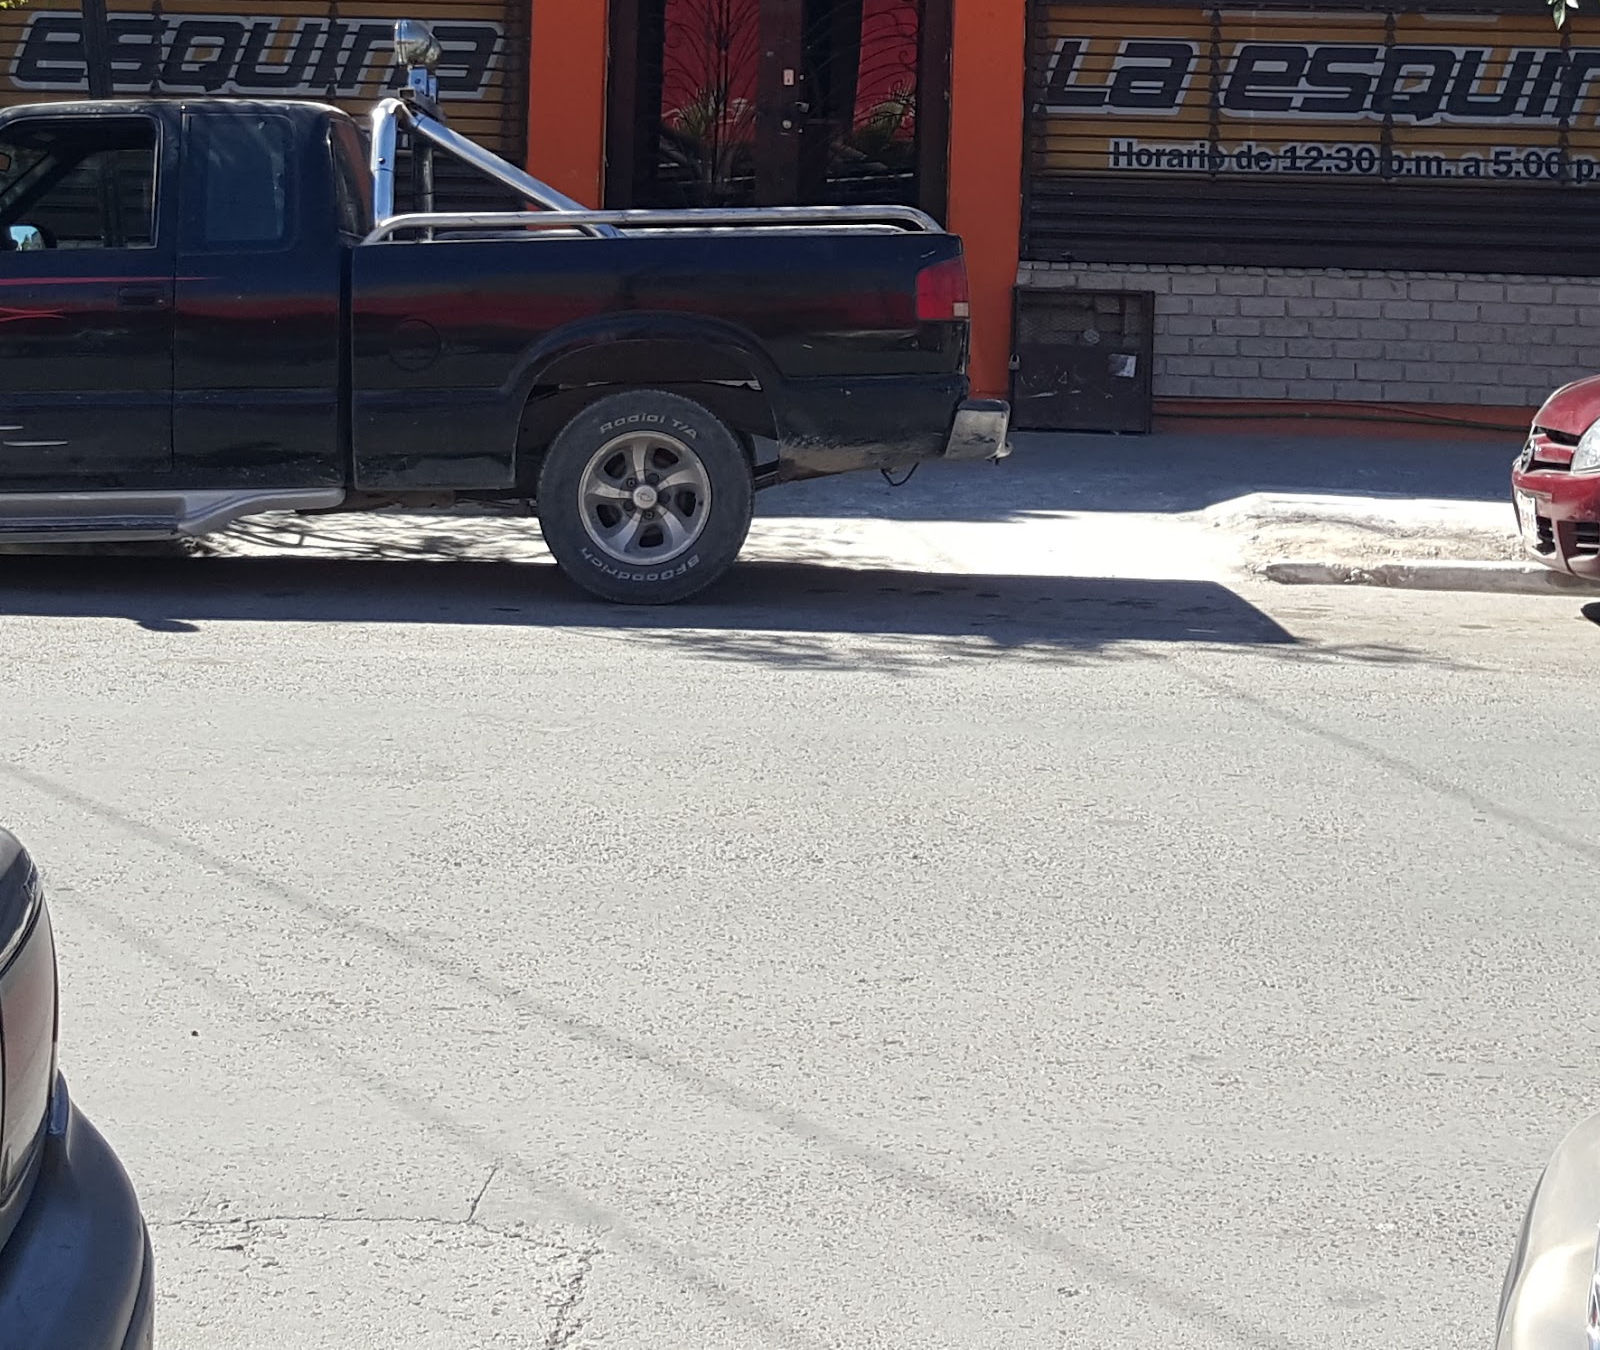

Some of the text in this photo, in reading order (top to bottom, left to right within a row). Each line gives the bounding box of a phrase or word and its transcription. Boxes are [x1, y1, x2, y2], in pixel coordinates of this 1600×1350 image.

[1110, 139, 1225, 172] Horario
[1234, 144, 1273, 173] de
[1281, 143, 1377, 175] 12:30
[1461, 157, 1483, 177] a
